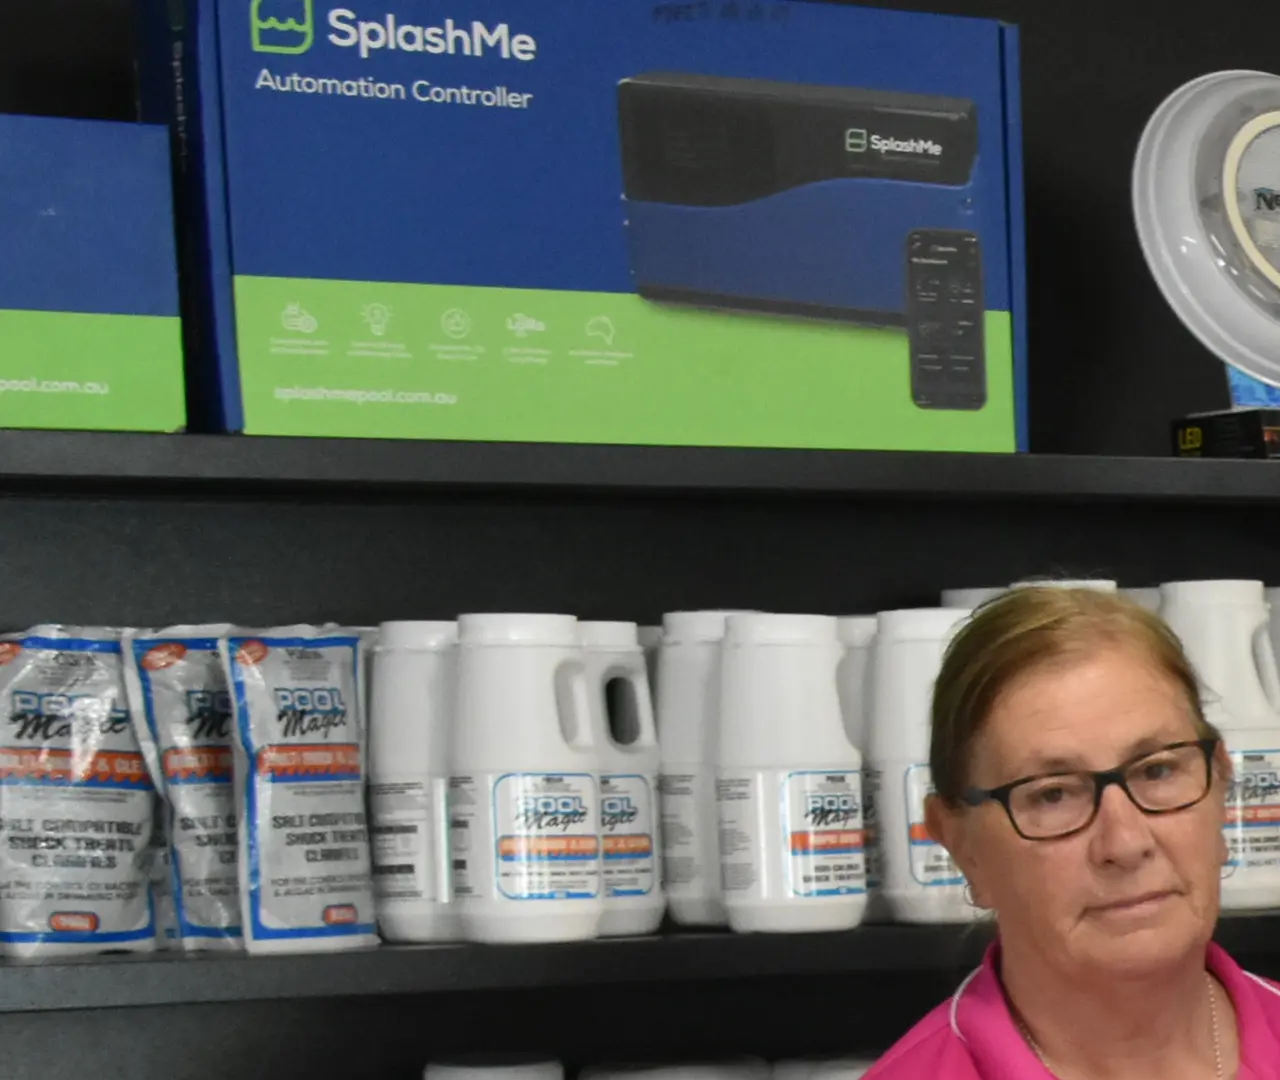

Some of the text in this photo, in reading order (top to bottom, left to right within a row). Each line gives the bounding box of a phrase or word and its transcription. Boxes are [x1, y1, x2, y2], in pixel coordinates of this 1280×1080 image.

[327, 8, 536, 61] SplashMe
[255, 69, 533, 109] Automation Controller
[870, 134, 942, 156] SplashMe
[1179, 427, 1203, 450] LED
[274, 687, 347, 716] POOL
[515, 796, 588, 815] POOL
